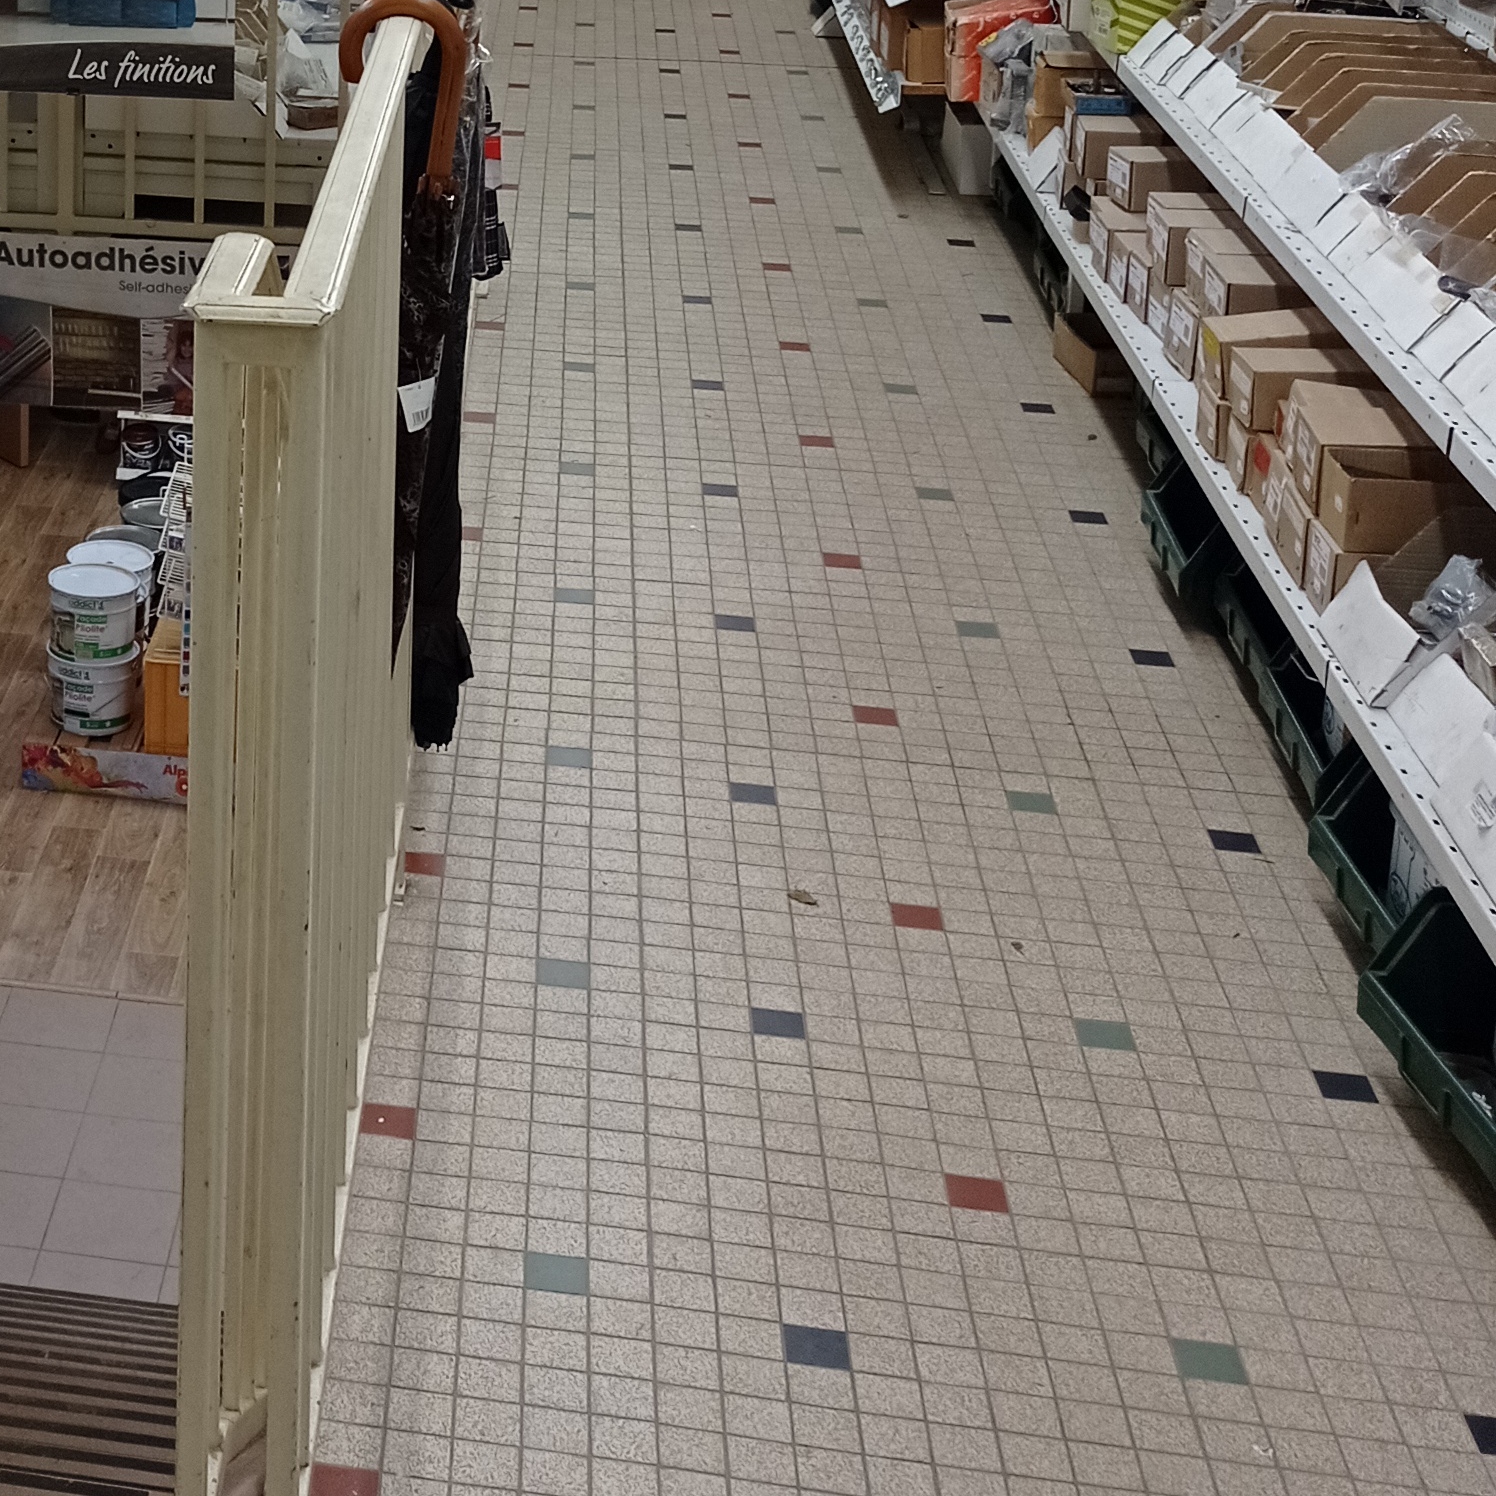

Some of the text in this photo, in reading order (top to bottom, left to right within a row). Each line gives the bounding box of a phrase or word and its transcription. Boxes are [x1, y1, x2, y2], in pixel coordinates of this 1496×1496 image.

[67, 48, 217, 88] Les finitions
[163, 764, 187, 780] Alp
